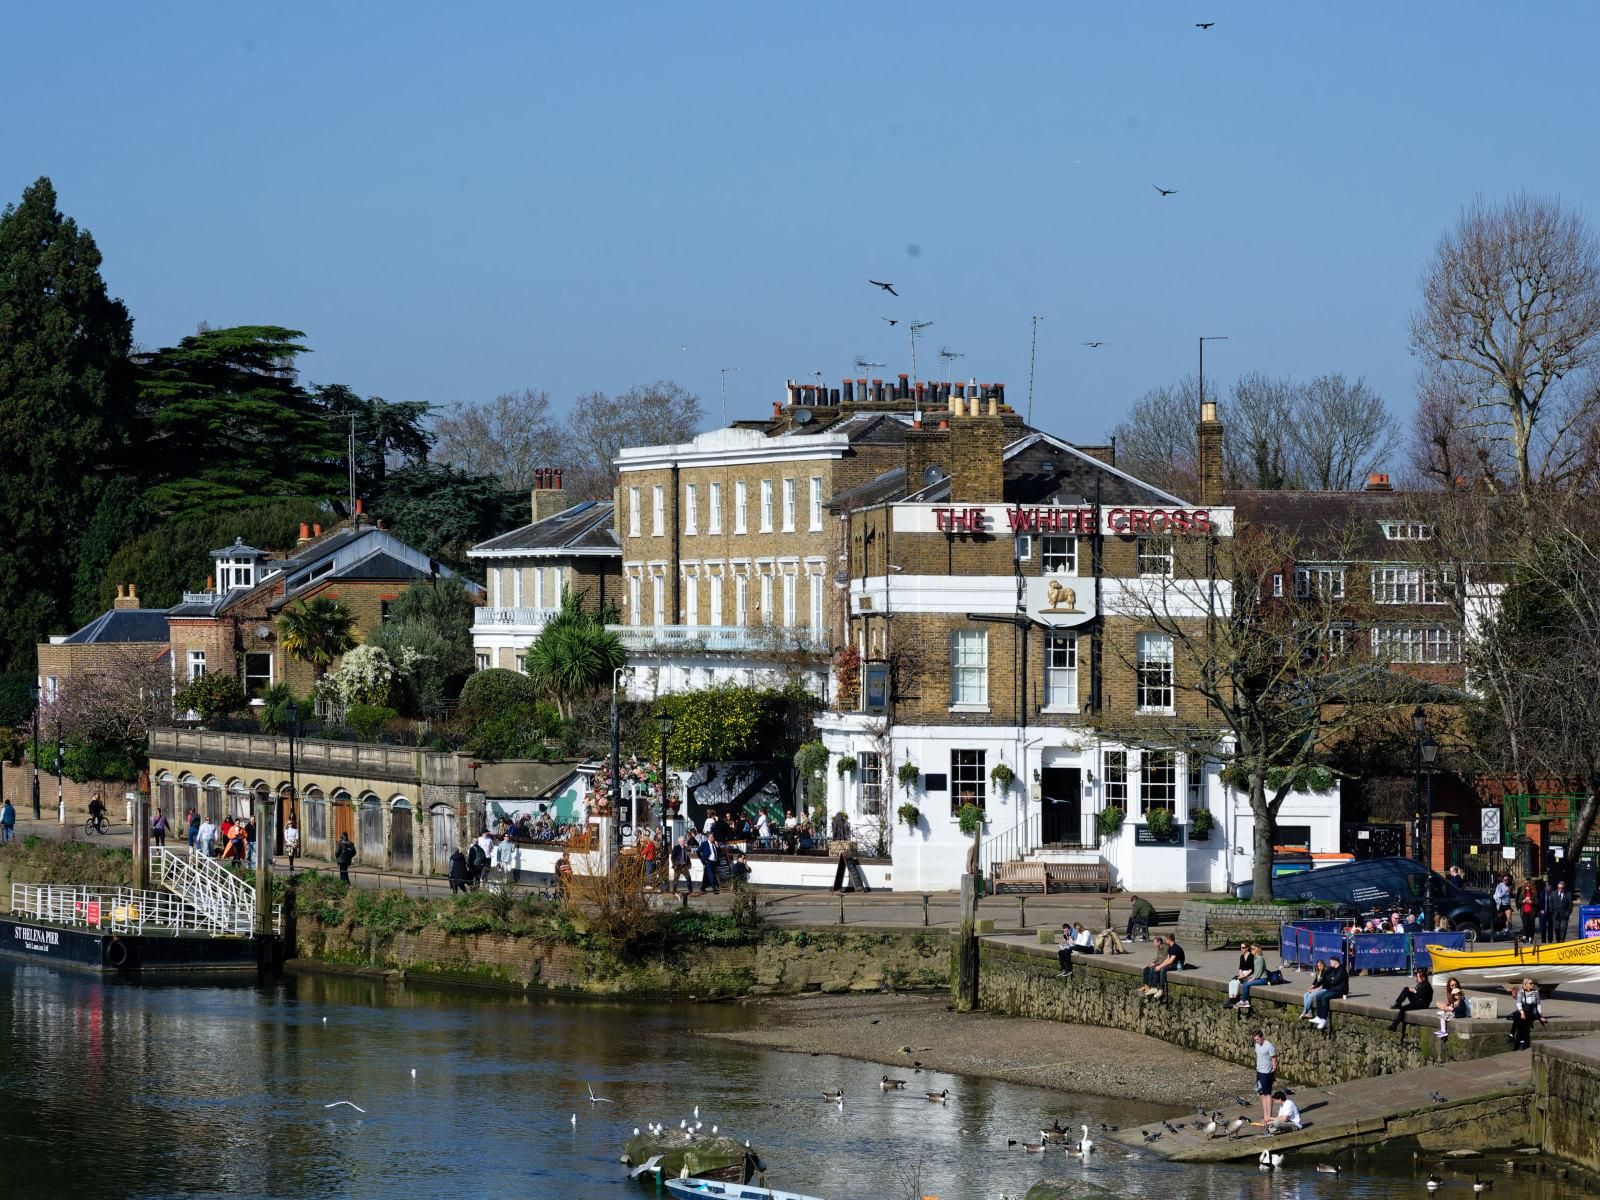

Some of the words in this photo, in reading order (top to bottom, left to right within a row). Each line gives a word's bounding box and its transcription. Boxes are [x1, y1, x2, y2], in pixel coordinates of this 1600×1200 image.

[932, 508, 986, 532] THE
[1007, 508, 1098, 533] WHITE
[1107, 508, 1211, 533] CROSS
[15, 926, 22, 939] ST
[22, 927, 45, 943] HELENA
[45, 930, 59, 945] PIER
[1557, 942, 1600, 960] LYONNESSE
